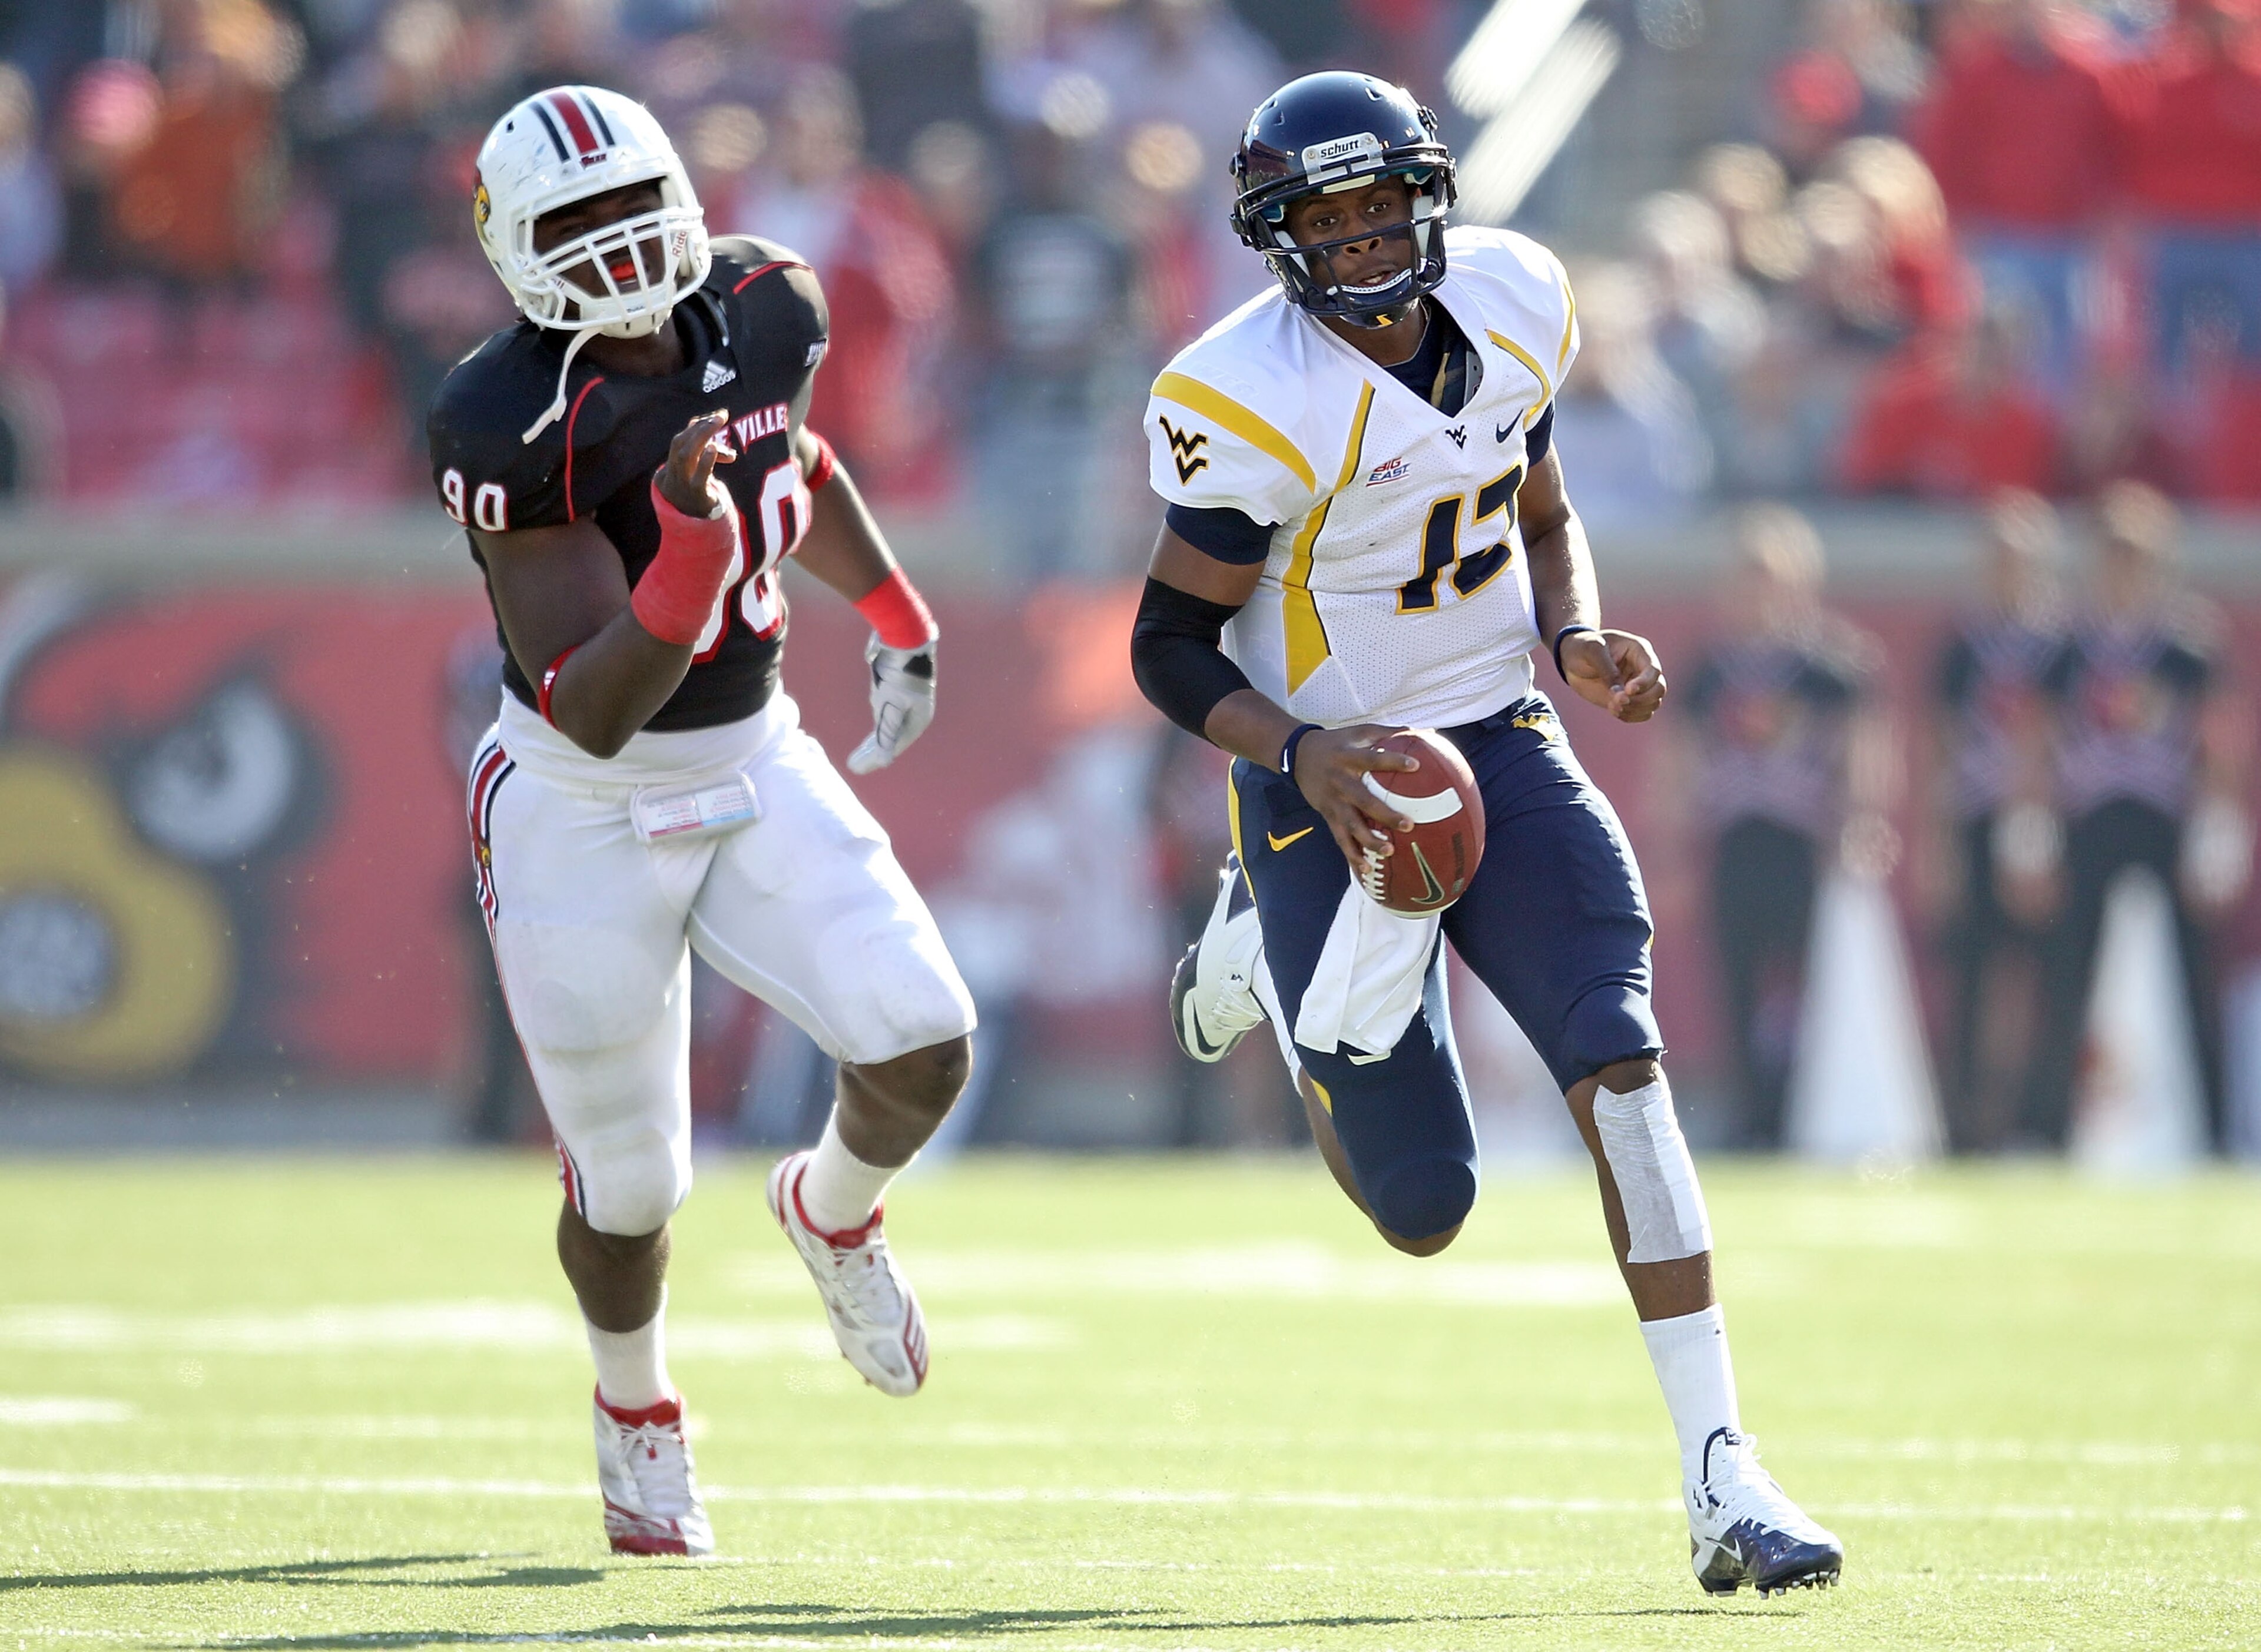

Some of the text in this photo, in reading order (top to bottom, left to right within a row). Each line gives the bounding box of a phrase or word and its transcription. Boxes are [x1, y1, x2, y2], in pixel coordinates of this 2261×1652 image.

[1321, 140, 1359, 158] schutt
[703, 369, 737, 393] adidas
[1368, 462, 1412, 482] EAST
[443, 469, 509, 532] 90
